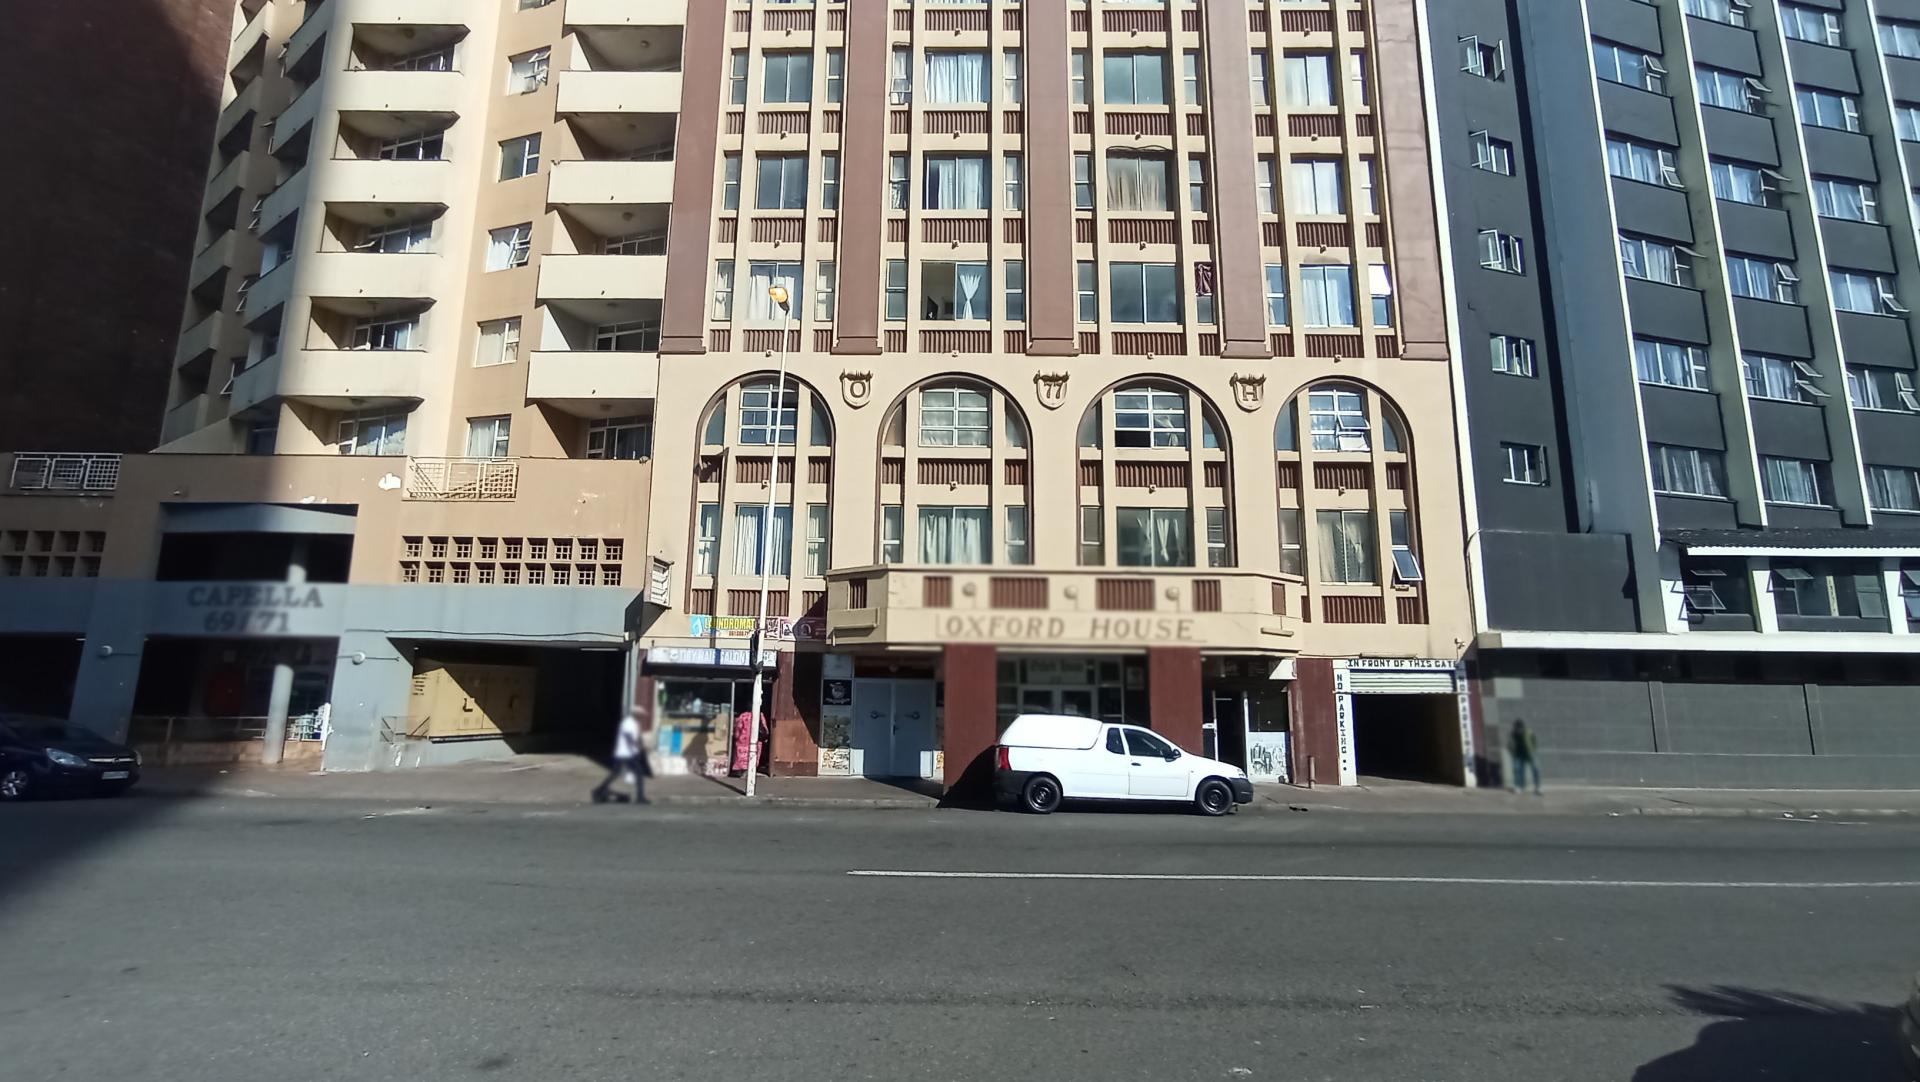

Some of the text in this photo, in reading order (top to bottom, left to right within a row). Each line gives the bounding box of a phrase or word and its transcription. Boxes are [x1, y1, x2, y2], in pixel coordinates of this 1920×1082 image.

[850, 381, 866, 398] O
[1044, 381, 1063, 399] 77
[1241, 383, 1259, 401] H
[187, 586, 323, 608] CAPELLA
[945, 615, 1195, 640] OXFORD HOUSE
[1347, 659, 1360, 668] IN
[1362, 659, 1391, 668] FRONT
[1394, 659, 1404, 668] OF
[1408, 659, 1432, 668] THIS
[1336, 674, 1344, 690] NO
